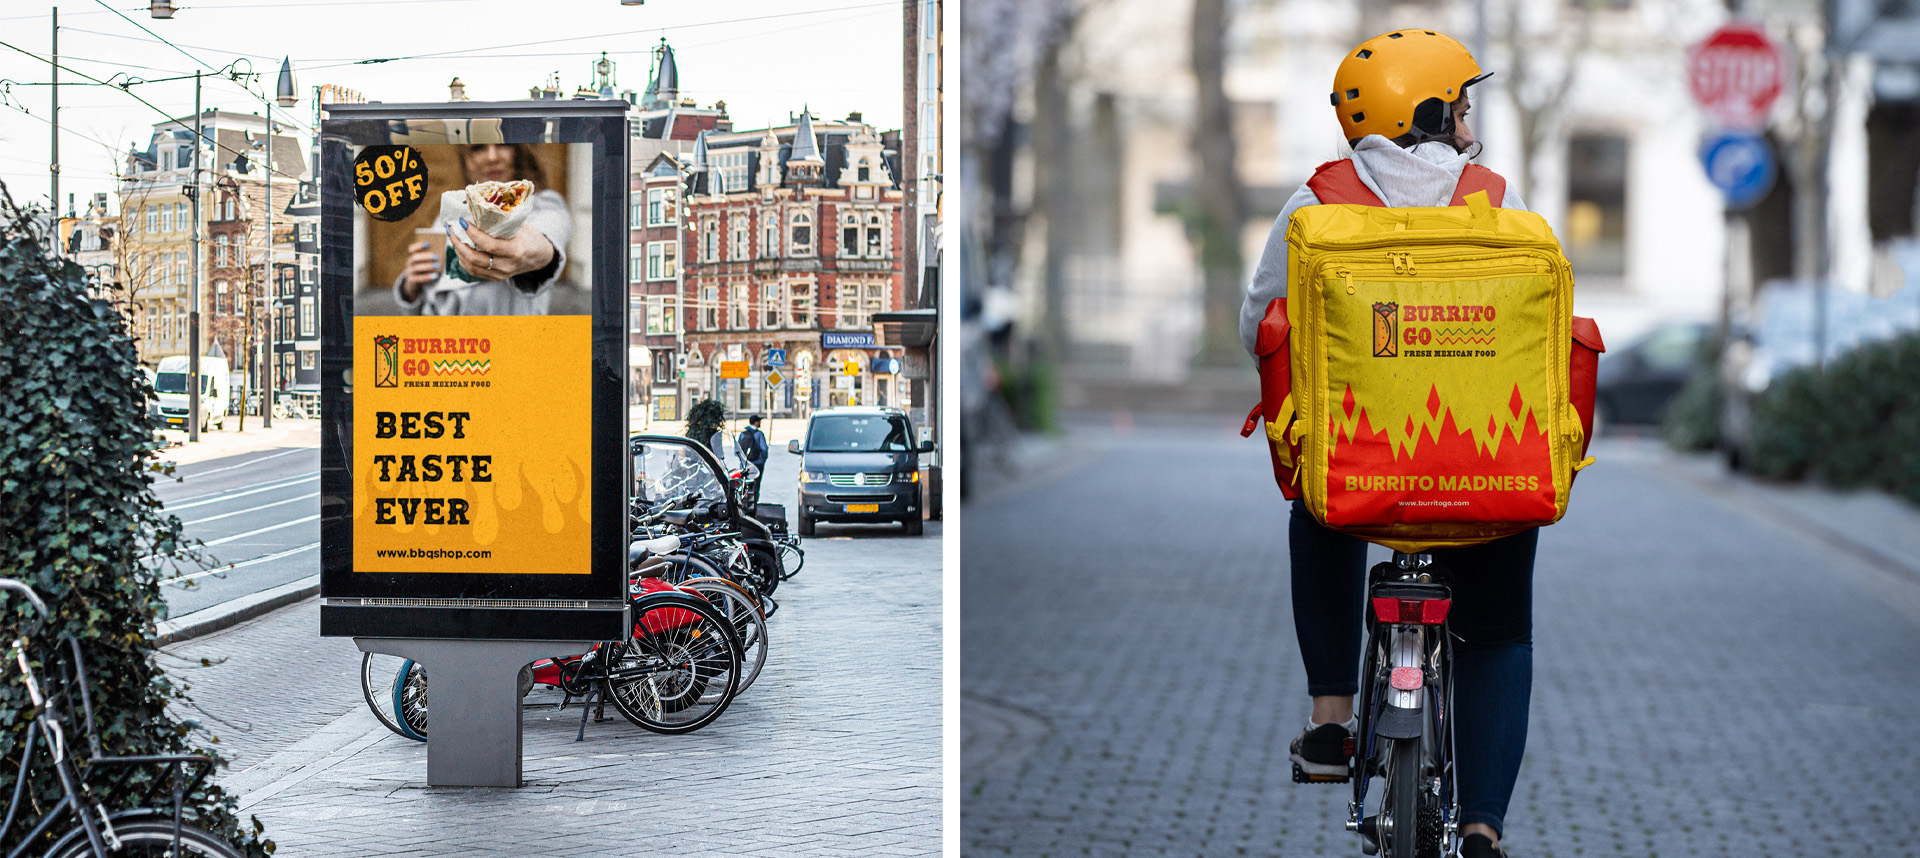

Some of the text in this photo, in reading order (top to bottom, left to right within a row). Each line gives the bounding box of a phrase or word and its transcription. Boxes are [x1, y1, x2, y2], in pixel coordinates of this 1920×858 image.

[1693, 54, 1777, 93] STOP
[355, 146, 418, 186] 50%
[363, 173, 423, 214] OFF
[1402, 305, 1496, 322] BURRITO
[826, 335, 866, 345] DIAMOND
[1402, 327, 1432, 346] GO
[402, 338, 491, 354] BURRITO
[1403, 350, 1497, 358] FRESH MEXICAN FOOD
[402, 358, 430, 377] GO
[403, 380, 491, 388] FRESH MEXICAN FOOD
[375, 411, 471, 439] BEST
[373, 454, 492, 482] TASTE
[1345, 475, 1539, 492] BURRITO MADNESS
[375, 498, 470, 525] EVER
[1398, 500, 1470, 508] www.burritogo.com
[376, 548, 492, 560] www.bbqshop.com
